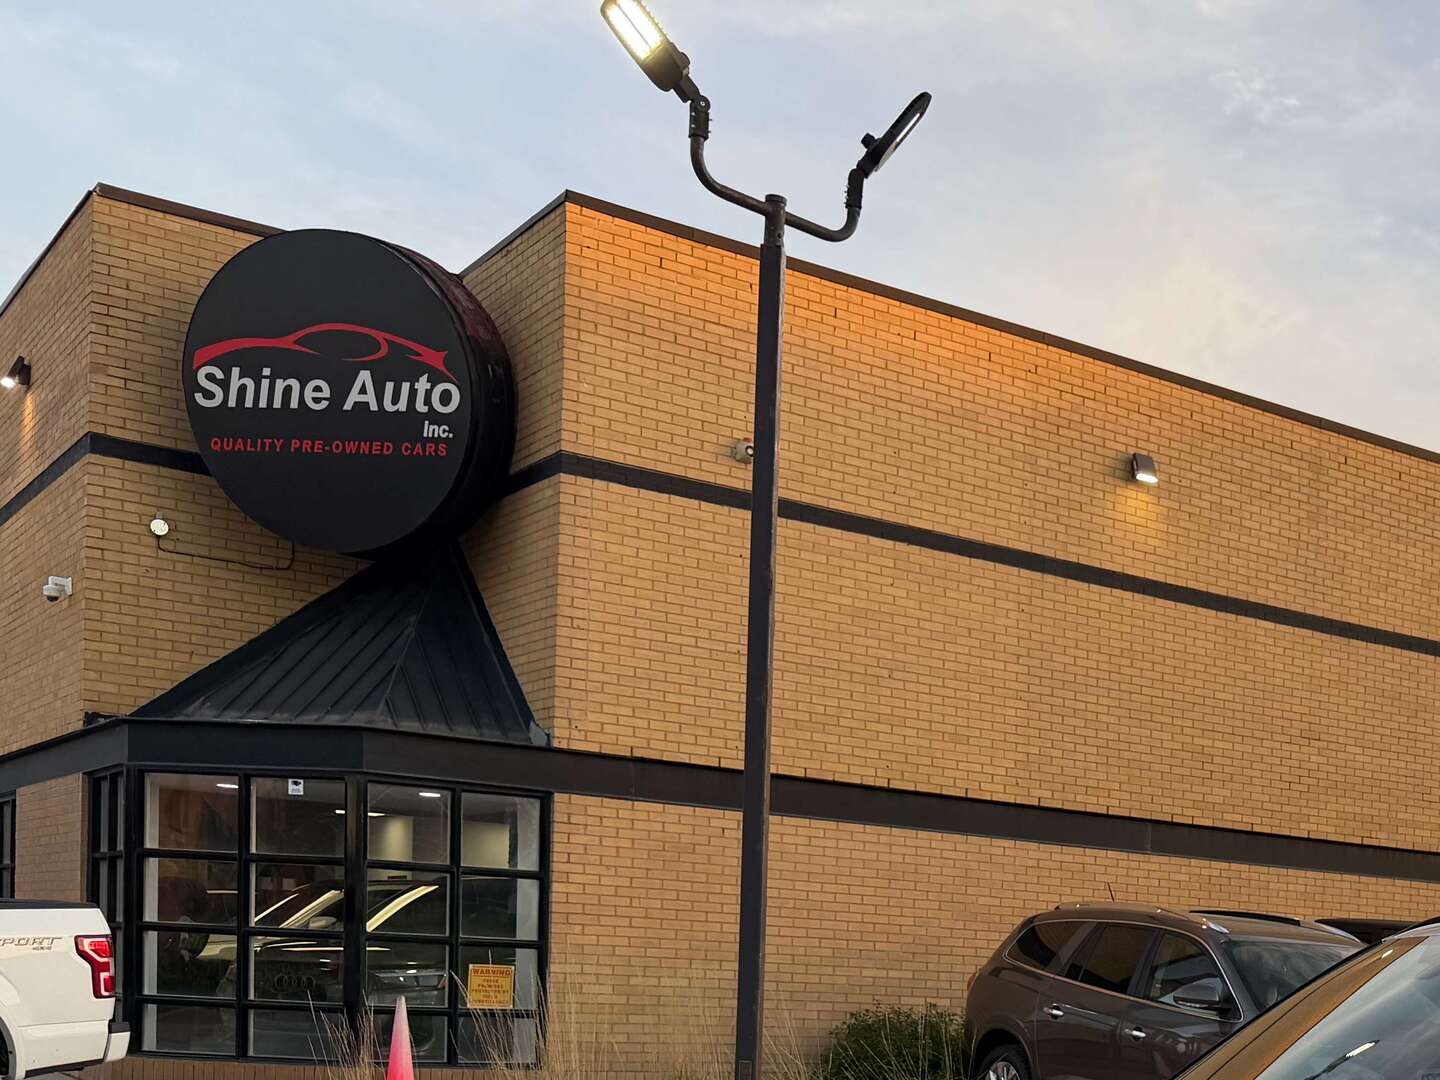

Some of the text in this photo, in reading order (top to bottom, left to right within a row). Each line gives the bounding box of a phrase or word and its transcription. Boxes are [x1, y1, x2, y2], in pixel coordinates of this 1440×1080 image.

[194, 366, 461, 414] Shine Auto
[423, 421, 453, 438] Inc.
[210, 438, 447, 456] QUALITY PRE-OWNED CARS
[0, 936, 62, 946] PORT
[472, 968, 511, 976] WARNING
